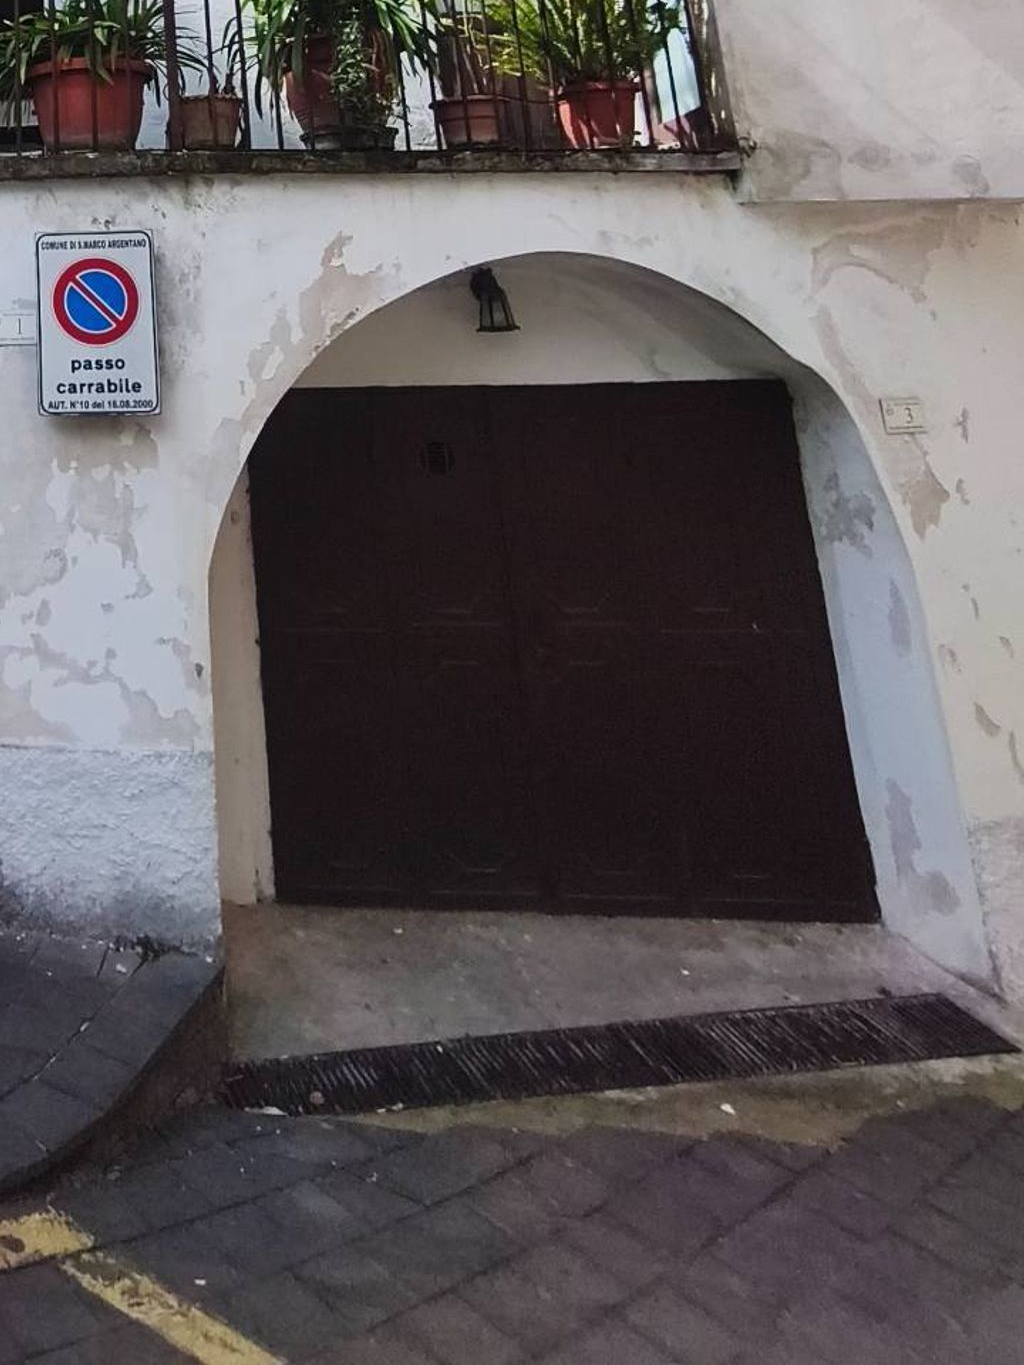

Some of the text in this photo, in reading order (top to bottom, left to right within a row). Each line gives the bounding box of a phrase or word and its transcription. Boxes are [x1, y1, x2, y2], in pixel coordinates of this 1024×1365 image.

[41, 240, 68, 250] COMUNE
[69, 240, 77, 250] DI
[107, 238, 146, 249] ARGENTANO
[71, 358, 125, 373] passo
[56, 378, 142, 394] carrabile
[48, 400, 68, 410] AUT.
[91, 400, 105, 410] del
[904, 407, 913, 424] 3
